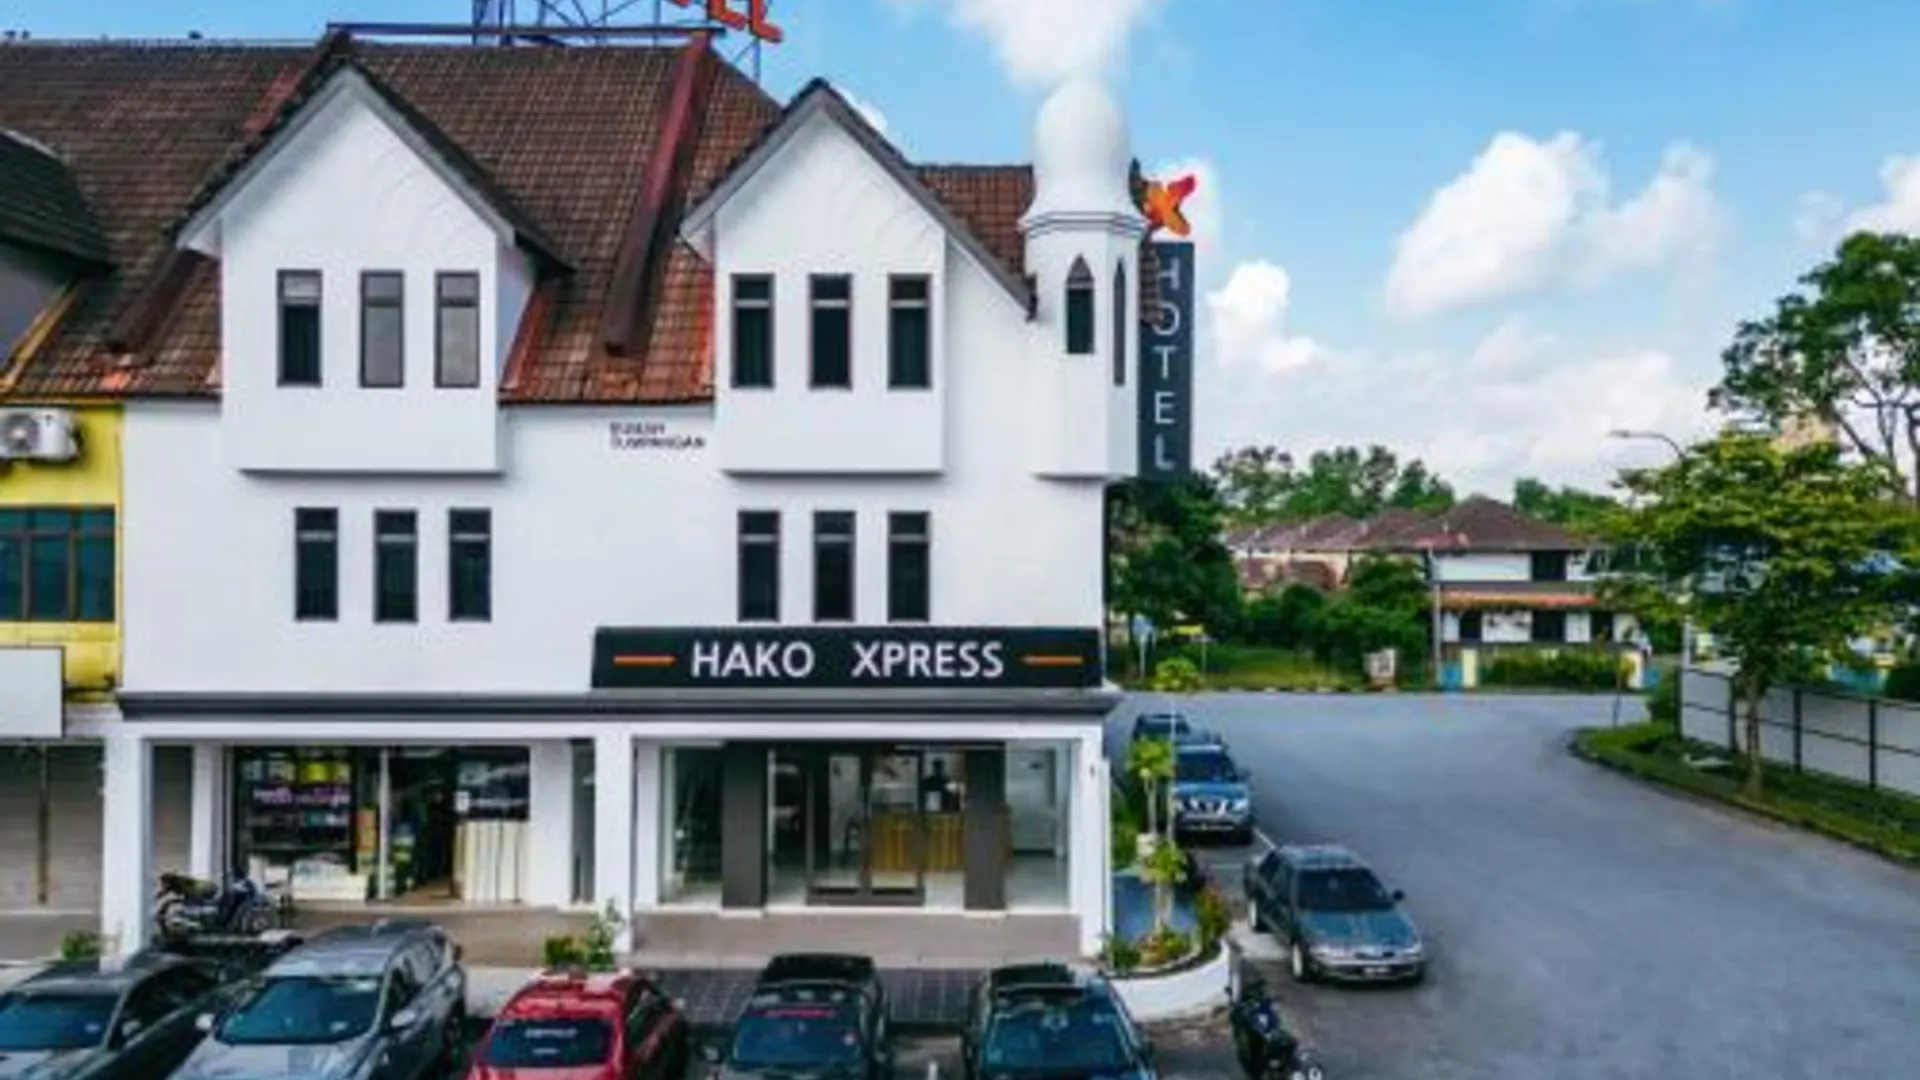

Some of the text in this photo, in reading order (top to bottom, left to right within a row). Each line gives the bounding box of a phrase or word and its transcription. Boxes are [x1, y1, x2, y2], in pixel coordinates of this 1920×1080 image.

[1151, 256, 1181, 471] HOTEL
[691, 642, 1004, 678] HAKO XPRESS
